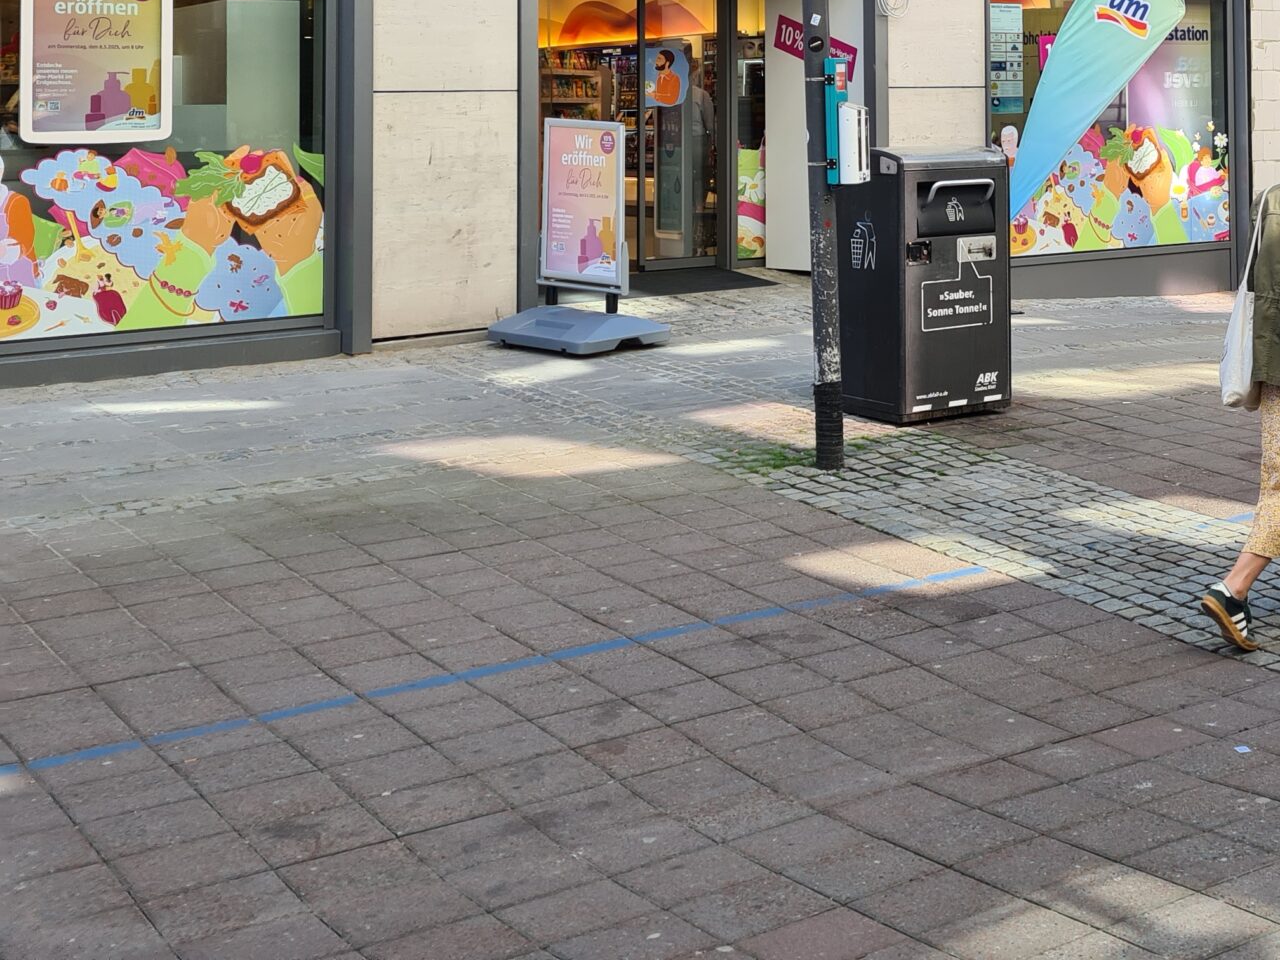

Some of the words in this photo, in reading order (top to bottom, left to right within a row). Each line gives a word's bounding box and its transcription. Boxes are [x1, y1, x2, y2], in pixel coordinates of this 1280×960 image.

[63, 17, 87, 40] für
[88, 16, 132, 40] Dich
[1165, 25, 1208, 42] station
[780, 24, 804, 51] 10%
[128, 108, 145, 117] dm
[575, 134, 593, 150] Wir
[562, 151, 606, 167] eröffnen
[927, 307, 954, 318] Sonne
[976, 371, 999, 384] ABK
